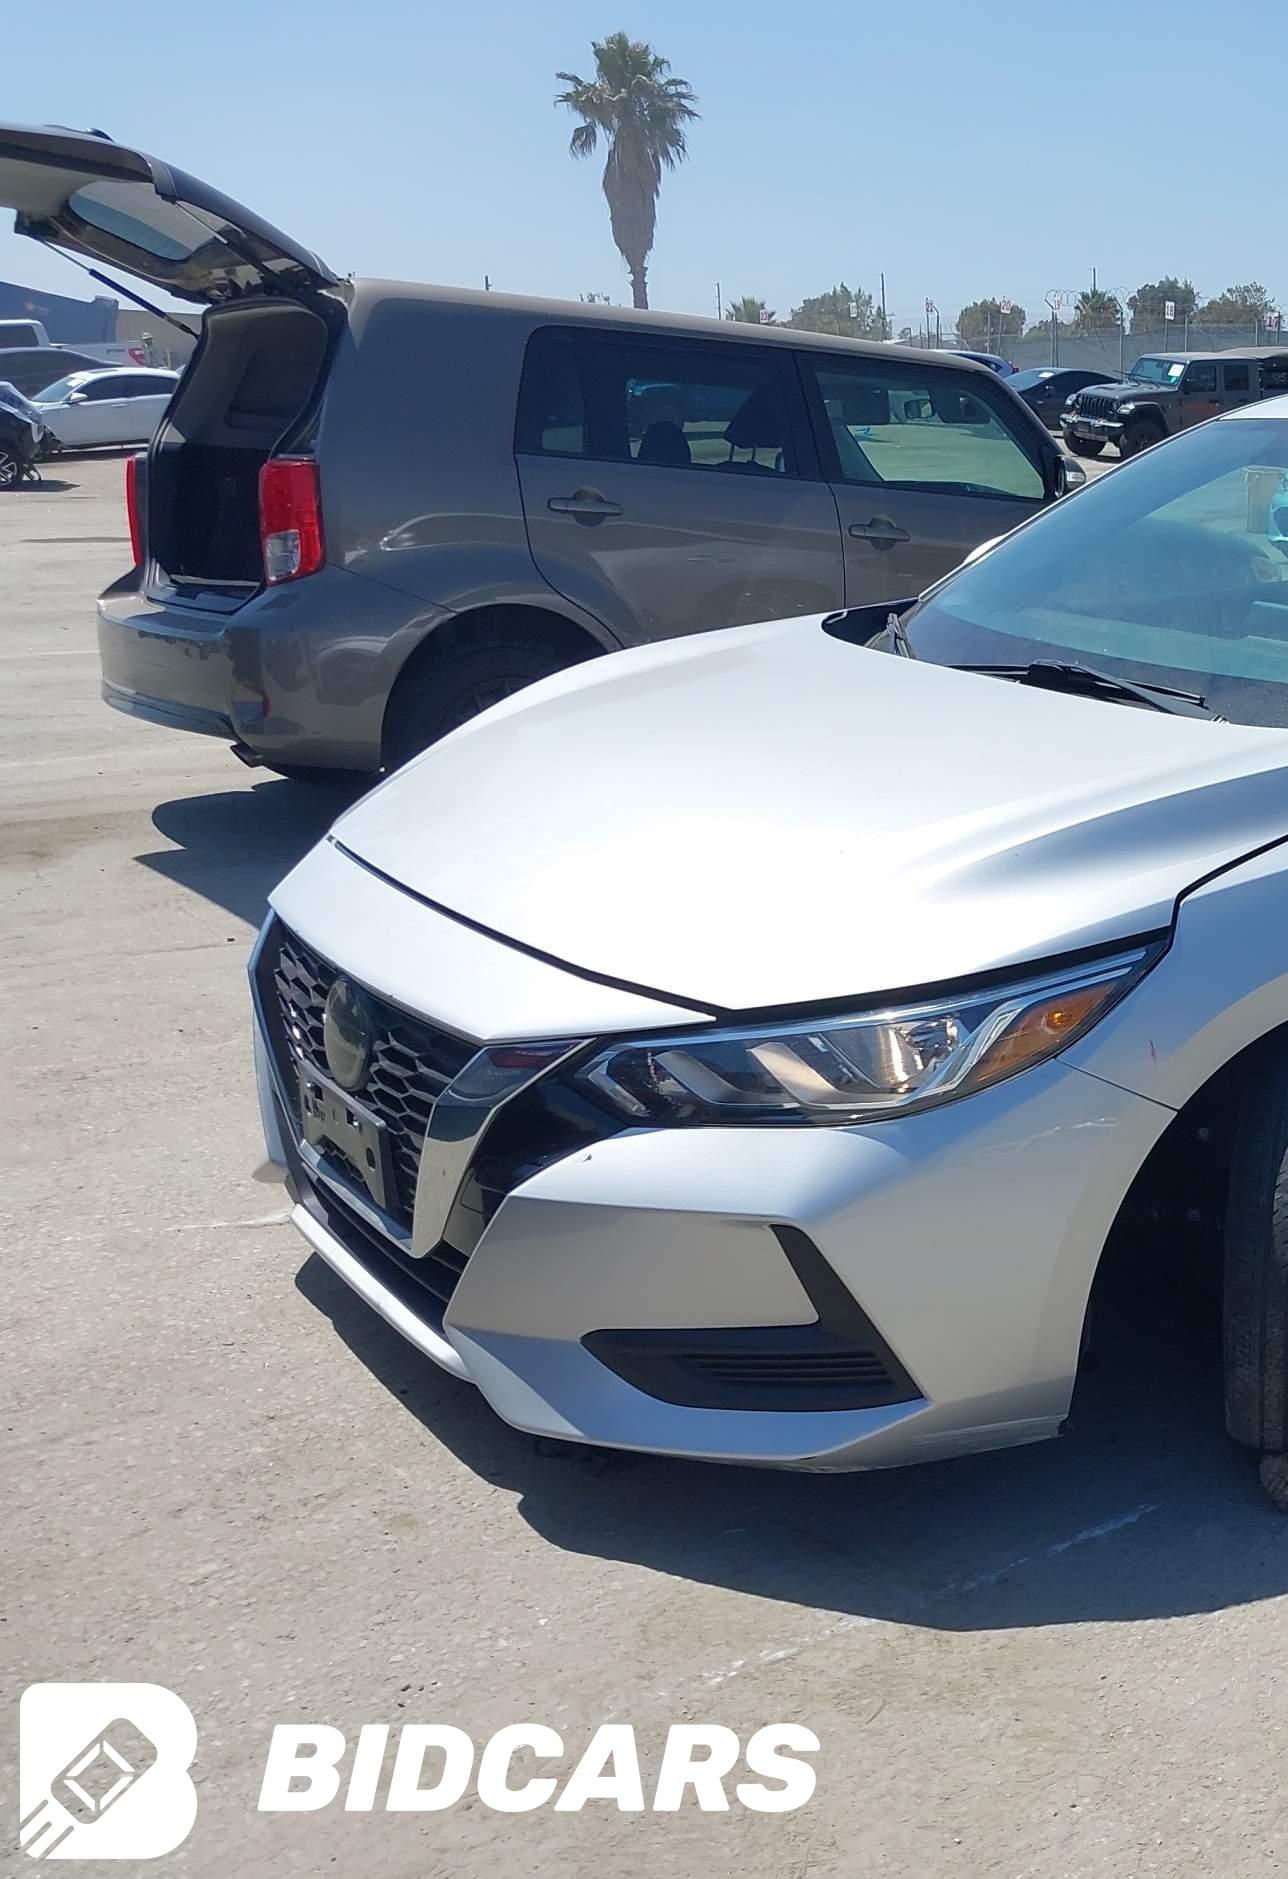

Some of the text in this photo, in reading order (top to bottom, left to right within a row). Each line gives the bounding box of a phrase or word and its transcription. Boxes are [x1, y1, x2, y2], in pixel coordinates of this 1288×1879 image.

[1001, 300, 1011, 311] 20
[1166, 304, 1174, 317] 18
[1266, 315, 1279, 327] 17
